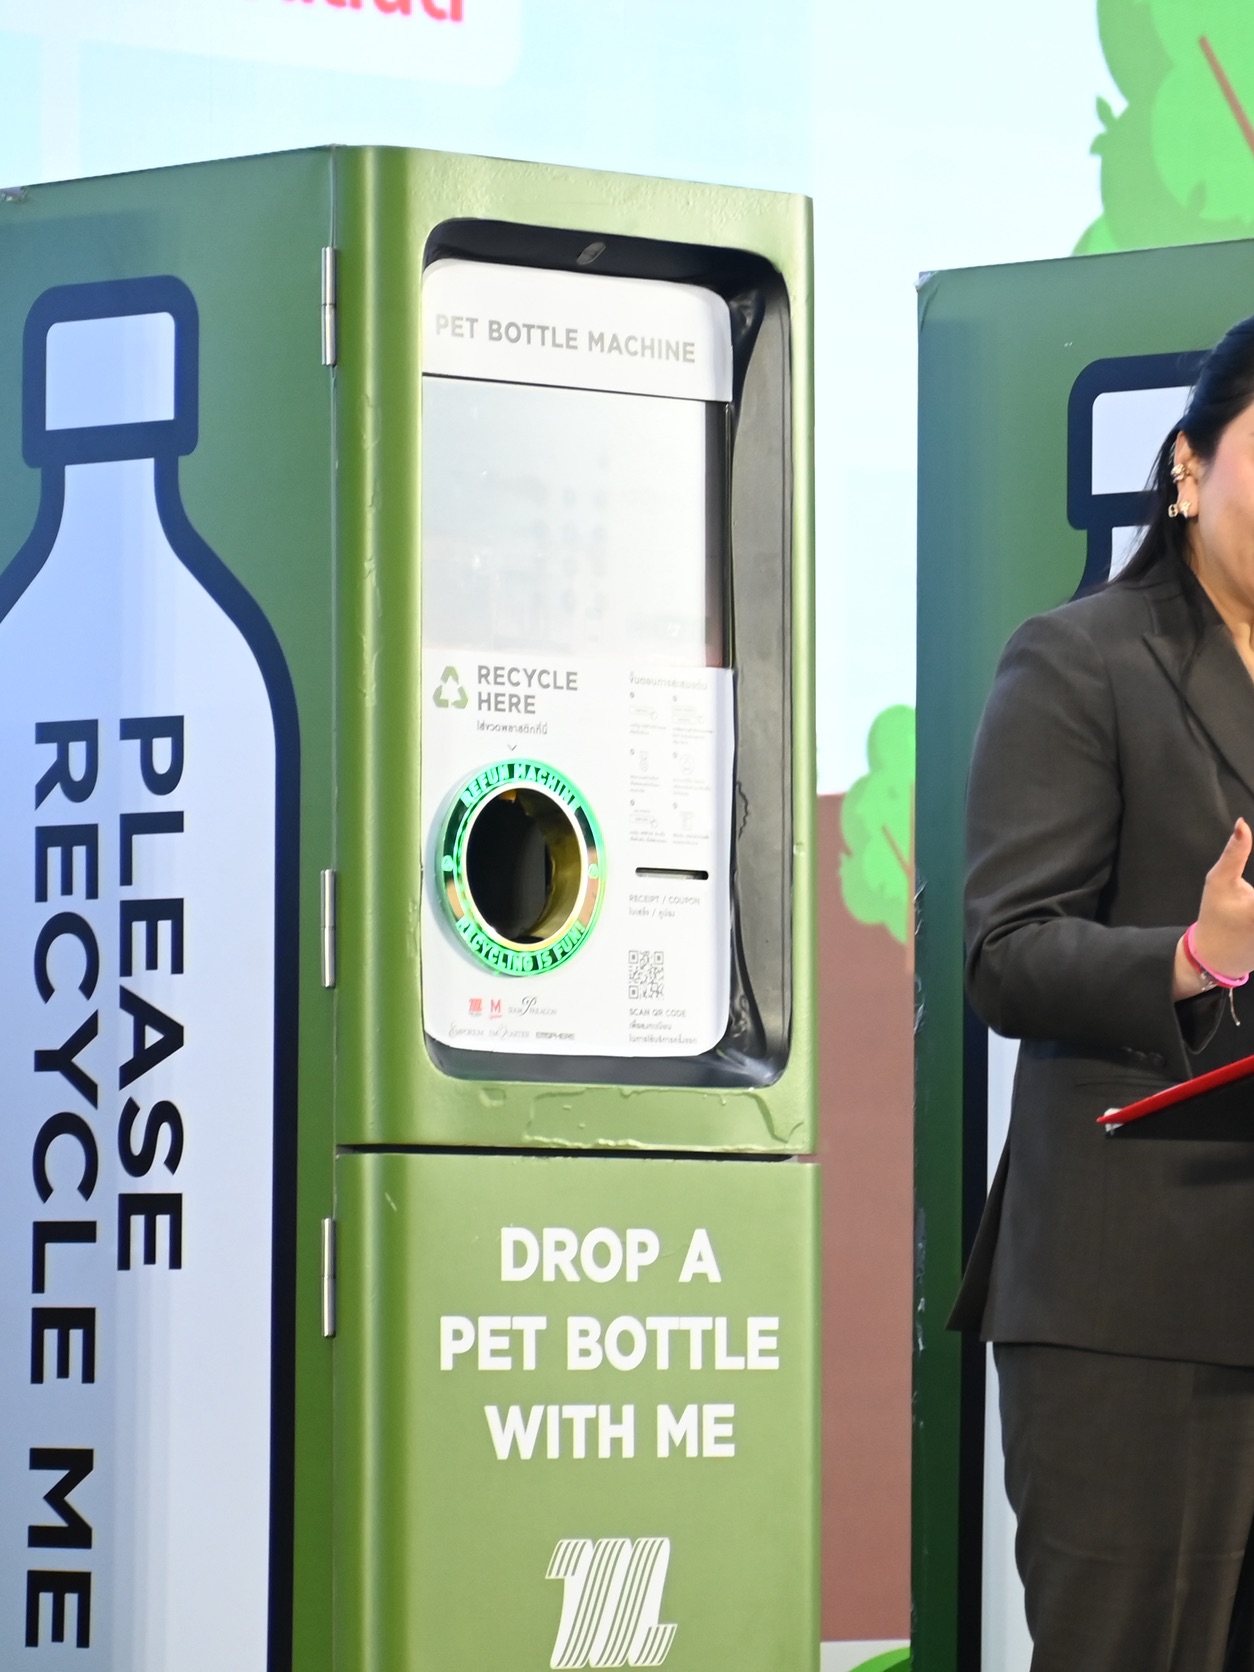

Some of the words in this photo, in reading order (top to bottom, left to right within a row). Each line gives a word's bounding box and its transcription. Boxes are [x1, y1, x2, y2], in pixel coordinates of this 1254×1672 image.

[436, 314, 479, 339] PET
[488, 319, 579, 350] BOTTLE
[587, 330, 696, 364] MACHINE
[477, 664, 578, 692] RECYCLE
[477, 691, 536, 715] HERE
[460, 763, 511, 809] REFUN
[116, 714, 185, 1272] PLEASE
[29, 718, 100, 1385] RECYCLE
[500, 1226, 660, 1284] DROP
[678, 1228, 722, 1283] A
[439, 1315, 548, 1371] PET
[566, 1315, 780, 1372] BOTTLE
[483, 1403, 635, 1461] WITH
[656, 1403, 736, 1458] ME
[24, 1447, 95, 1649] ME
